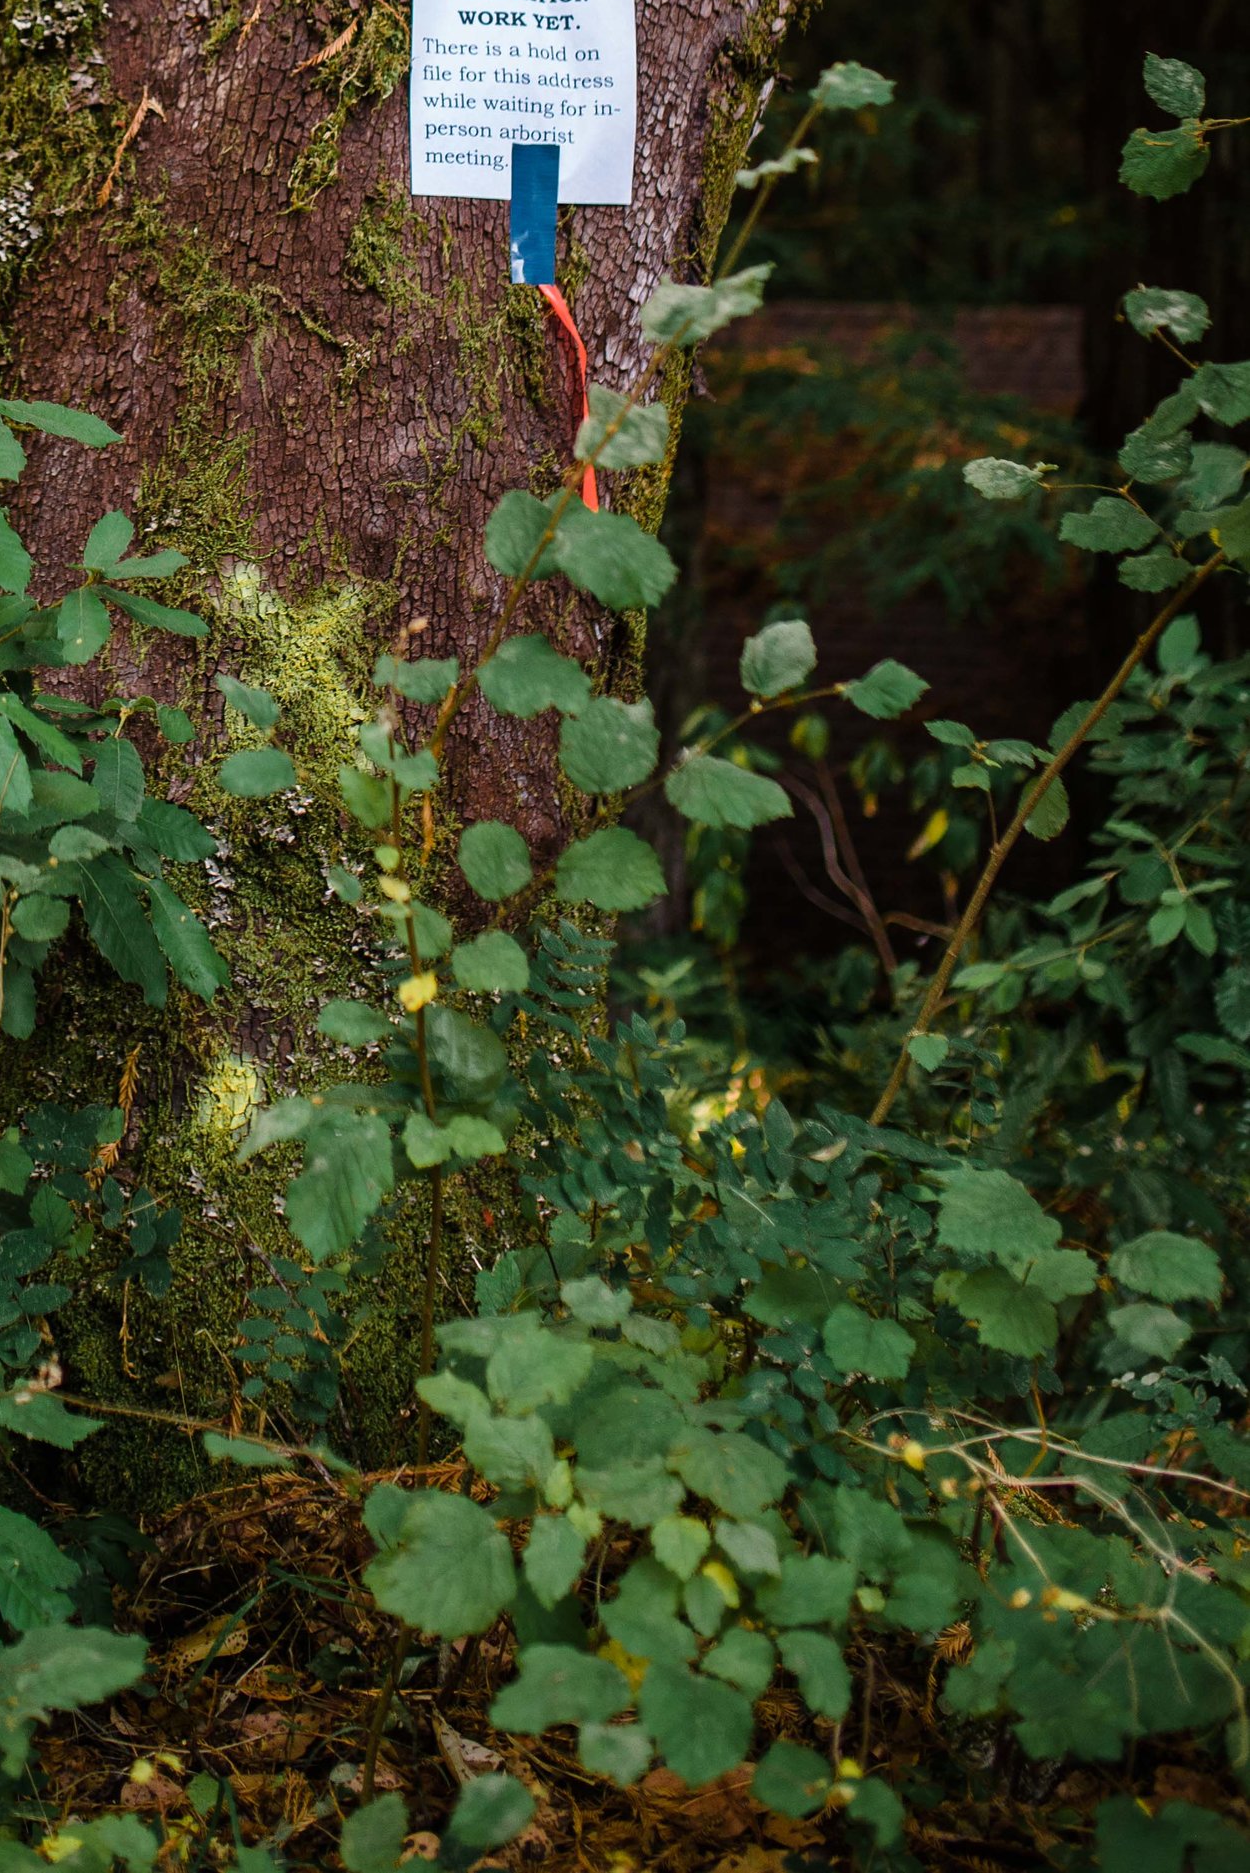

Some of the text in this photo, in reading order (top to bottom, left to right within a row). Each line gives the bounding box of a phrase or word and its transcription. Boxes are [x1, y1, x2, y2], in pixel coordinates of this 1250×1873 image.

[458, 11, 581, 30] WORK YET.
[422, 38, 600, 61] There is a hold on
[423, 65, 613, 89] file for this address
[424, 94, 620, 118] while waiting for in-
[424, 122, 575, 144] person arborist
[424, 149, 509, 170] meeting.
